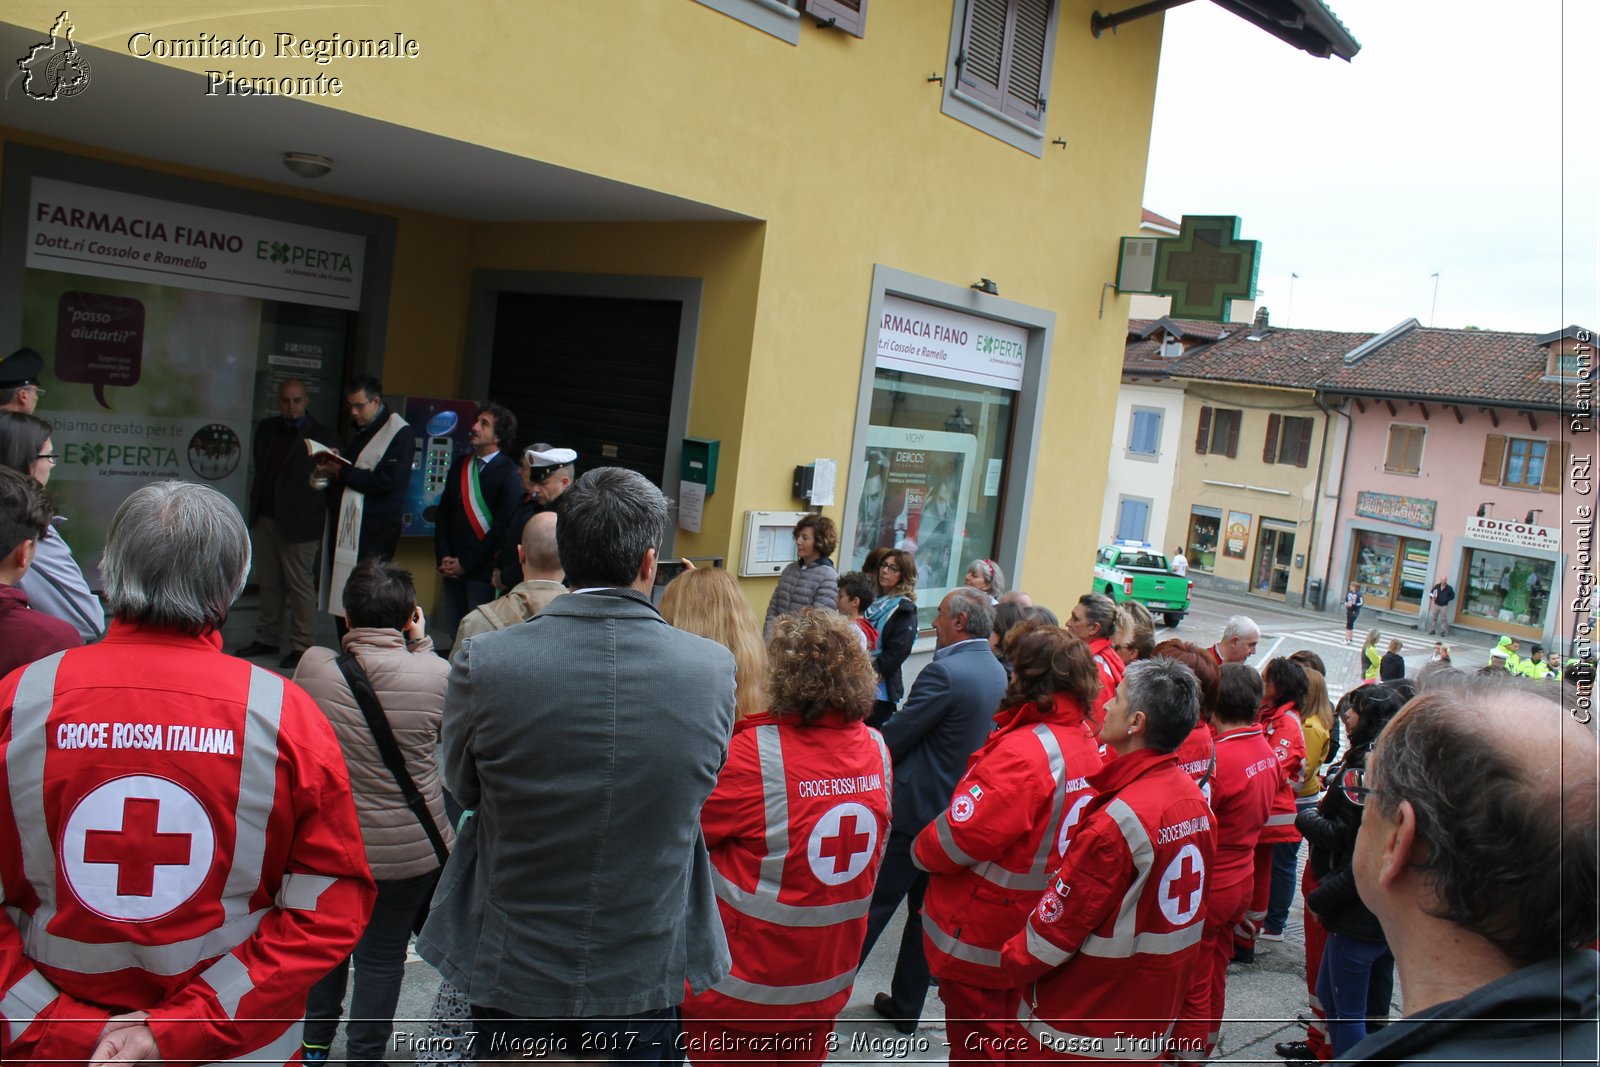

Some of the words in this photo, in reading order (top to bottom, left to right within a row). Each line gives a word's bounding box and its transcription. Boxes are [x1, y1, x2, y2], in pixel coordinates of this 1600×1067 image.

[36, 203, 168, 242] FARMACIA
[175, 226, 243, 254] FIANO
[35, 233, 85, 252] Dott.ri
[88, 241, 140, 261] Cossolo
[143, 252, 151, 262] e
[154, 251, 208, 270] Ramello
[880, 314, 931, 338] RMACIA
[934, 325, 968, 346] FIANO
[890, 341, 915, 354] Cossolo
[916, 347, 921, 355] e
[921, 346, 948, 361] Ramello
[101, 422, 143, 435] creato
[146, 425, 168, 438] per
[171, 424, 183, 437] te
[1467, 527, 1509, 537] CARTOLERIA
[1517, 534, 1536, 542] LIBRI
[1543, 538, 1558, 546] DVD
[1478, 519, 1548, 538] EDICOLA
[1473, 533, 1514, 544] GIOCATTOLI
[1521, 541, 1550, 550] GADGET
[57, 722, 109, 750] CROCE
[112, 722, 163, 750] ROSSA
[166, 725, 235, 755] ITALIANA
[799, 780, 831, 798] CROCE
[832, 777, 857, 795] ROSSA
[857, 773, 882, 793] ITALIANA
[1157, 825, 1180, 845] CROCE
